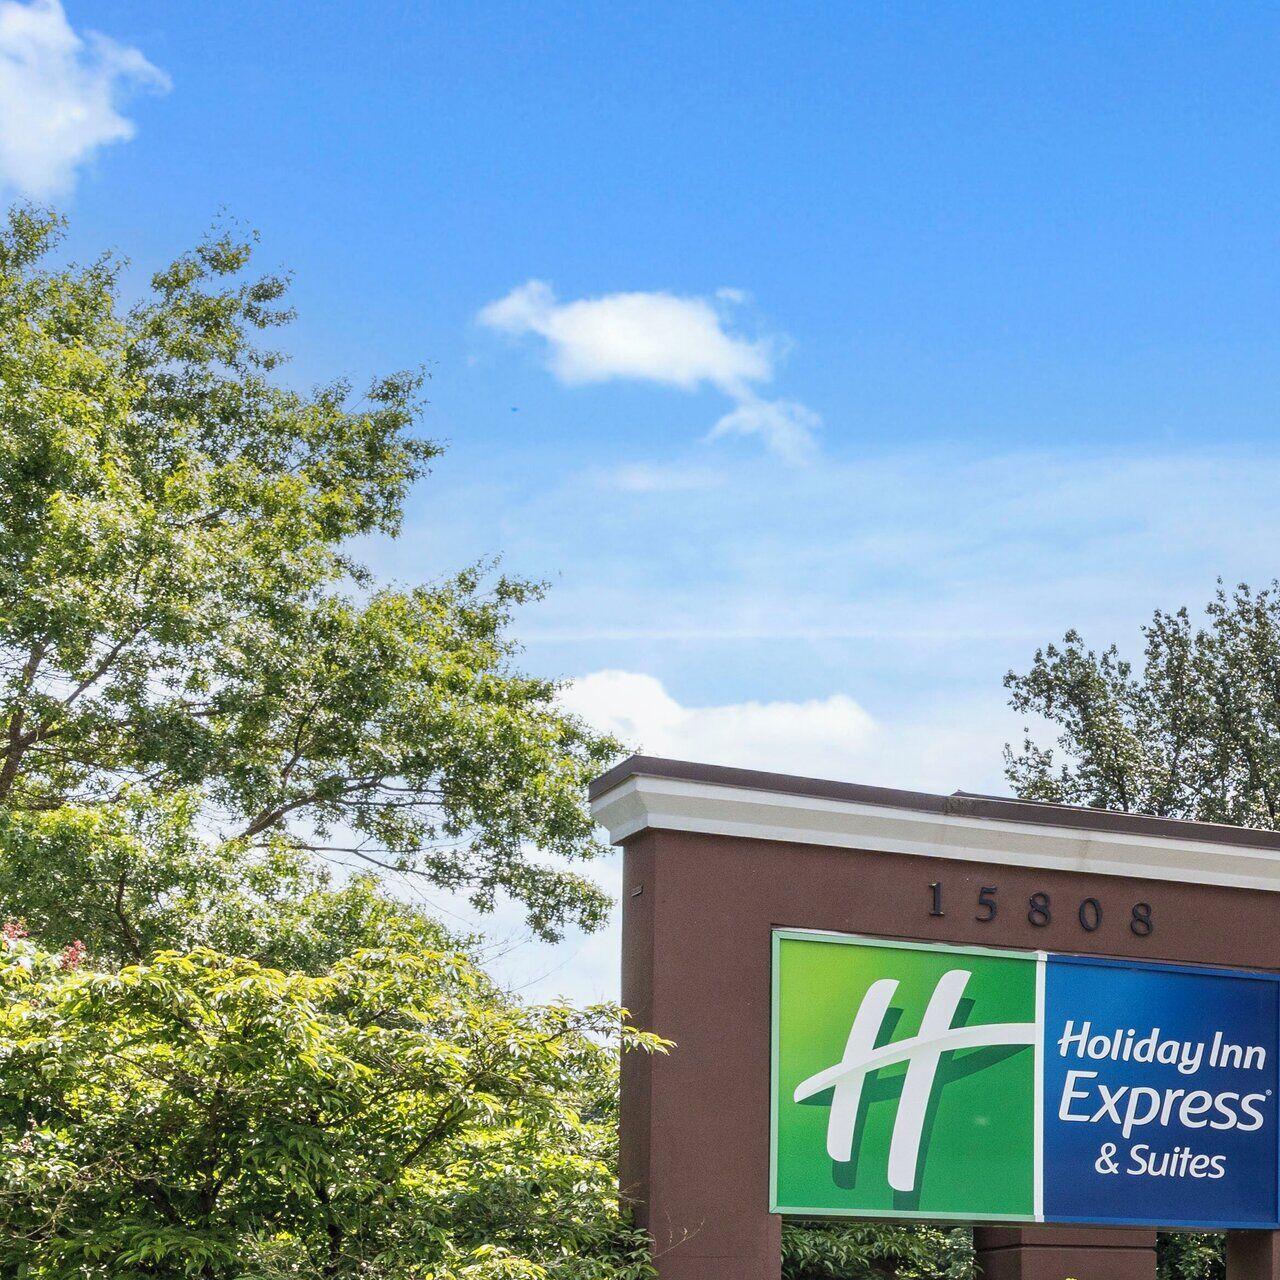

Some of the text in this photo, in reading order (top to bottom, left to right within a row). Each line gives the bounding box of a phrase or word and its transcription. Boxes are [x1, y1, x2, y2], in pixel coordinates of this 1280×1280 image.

[928, 882, 1153, 937] 15808
[1057, 1020, 1267, 1075] Holiday Inn
[1058, 1069, 1267, 1139] Express
[1094, 1142, 1227, 1179] & Suites
